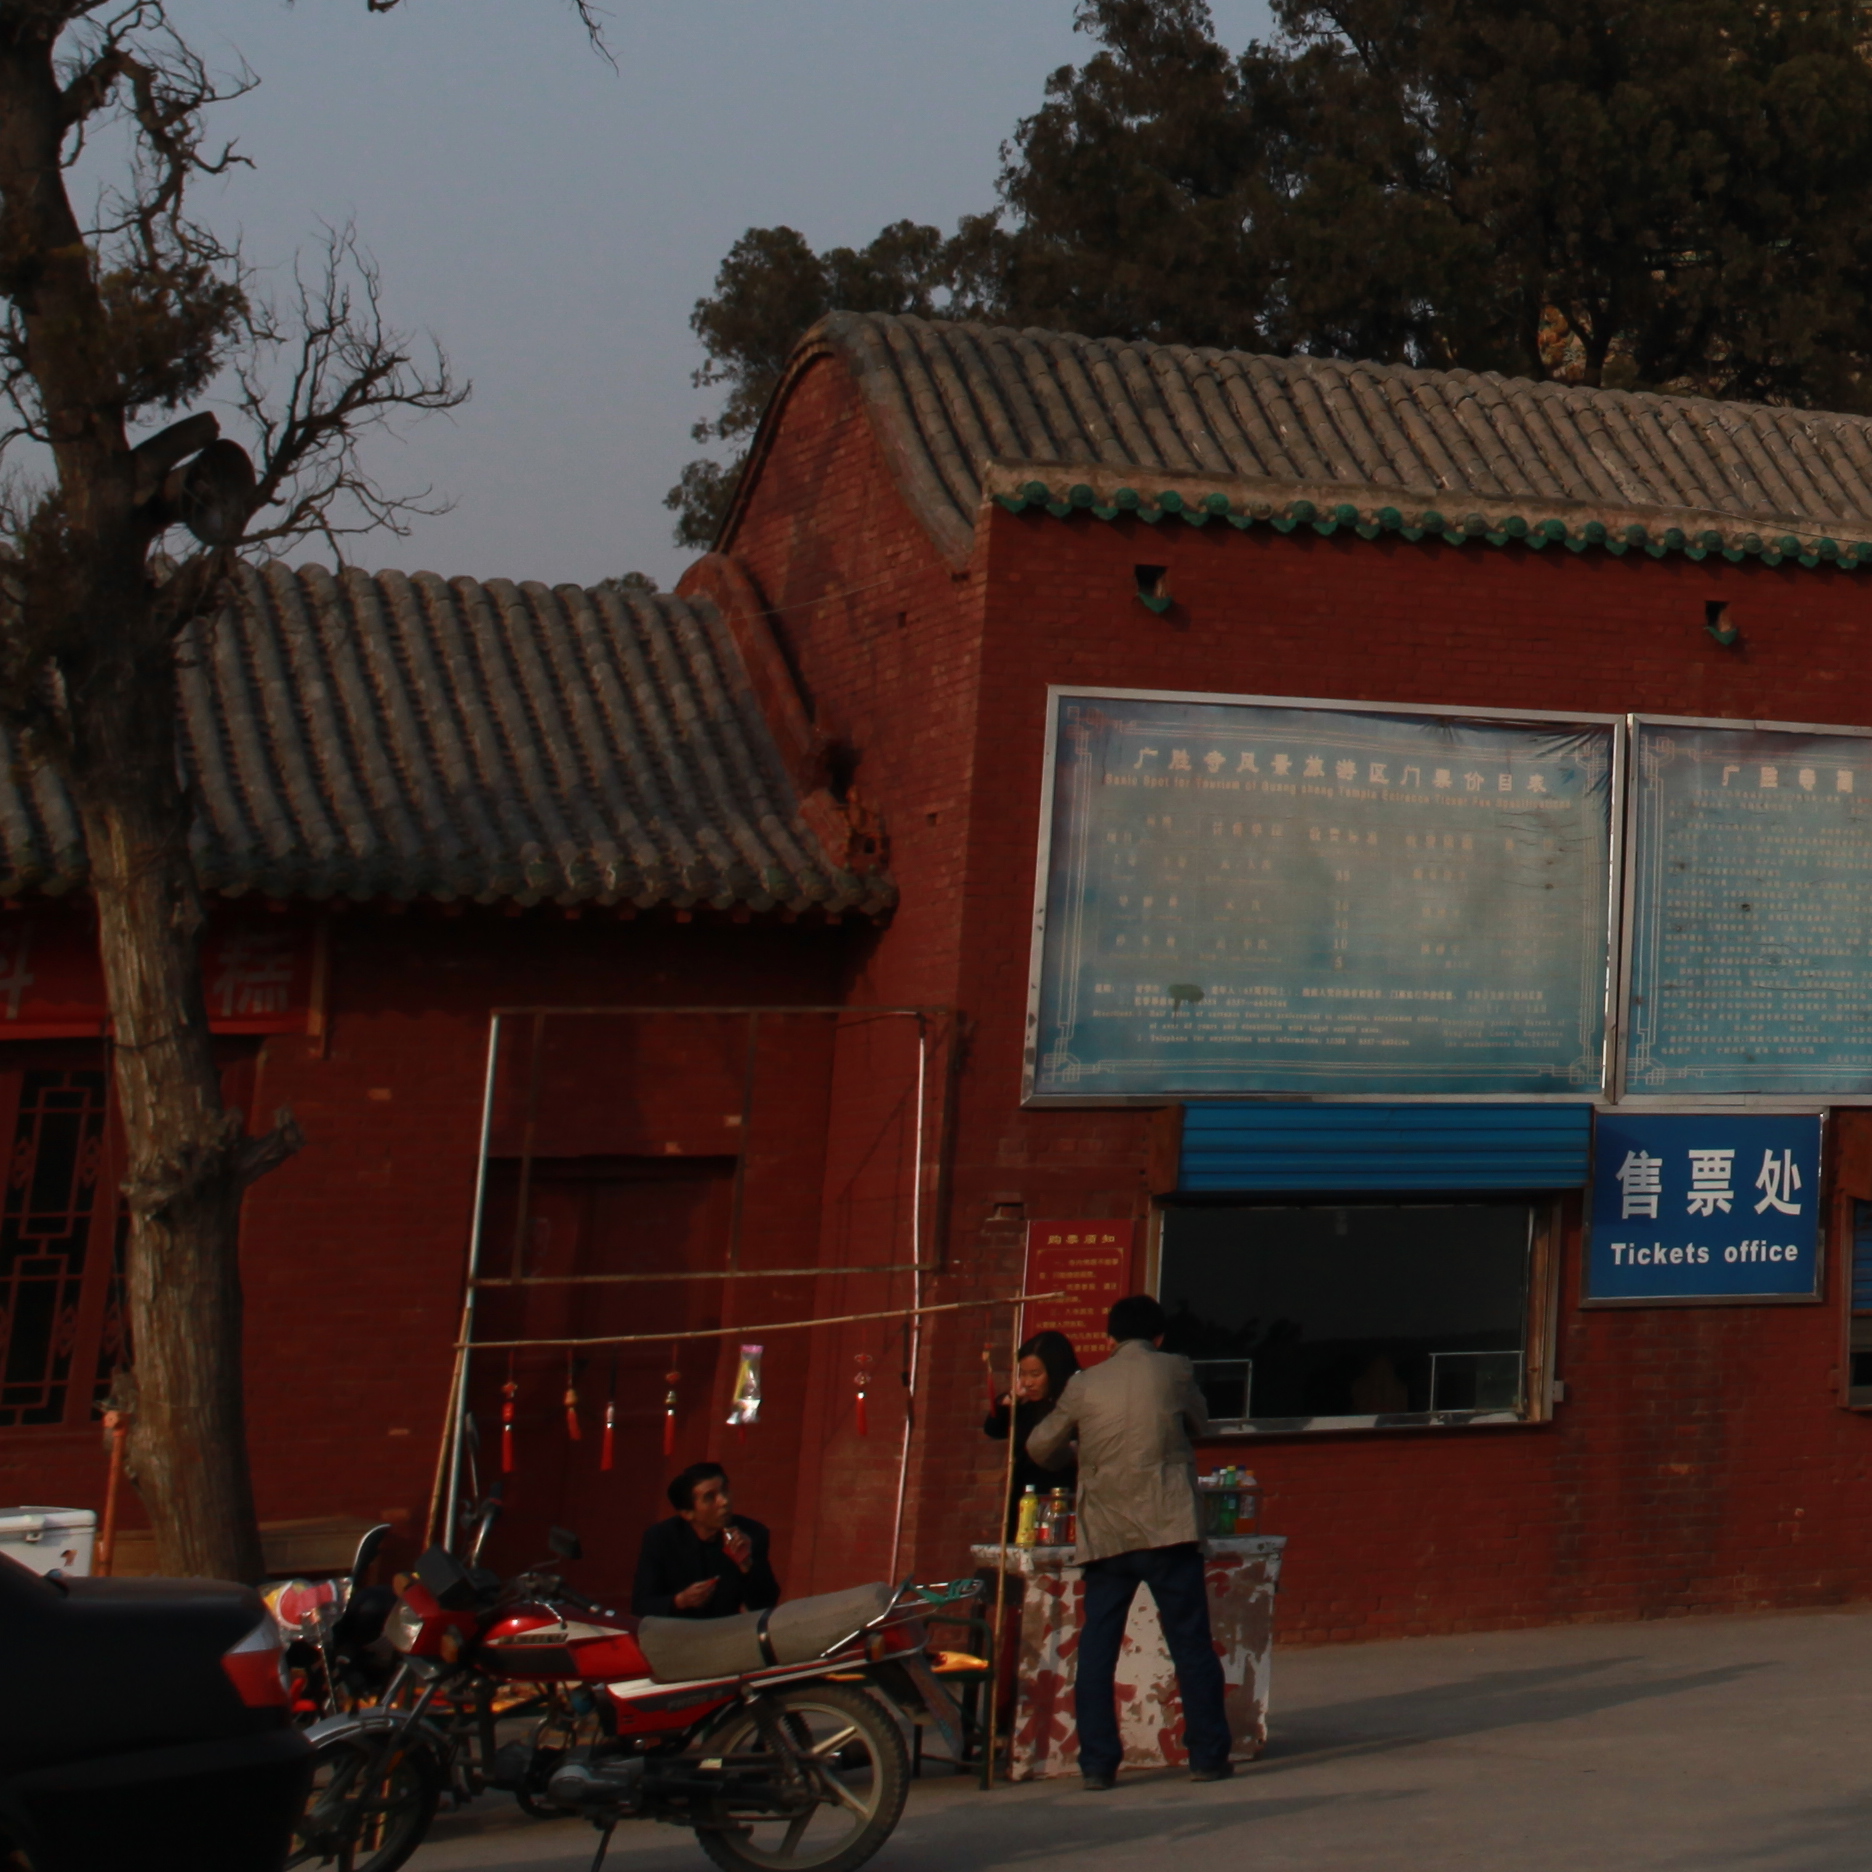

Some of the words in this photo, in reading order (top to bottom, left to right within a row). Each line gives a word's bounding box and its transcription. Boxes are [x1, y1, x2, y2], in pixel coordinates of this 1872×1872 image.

[1615, 1148, 1803, 1219] 售票处
[1046, 1233, 1117, 1246] 购票须知
[1611, 1241, 1710, 1266] Tickets
[1723, 1239, 1799, 1264] office
